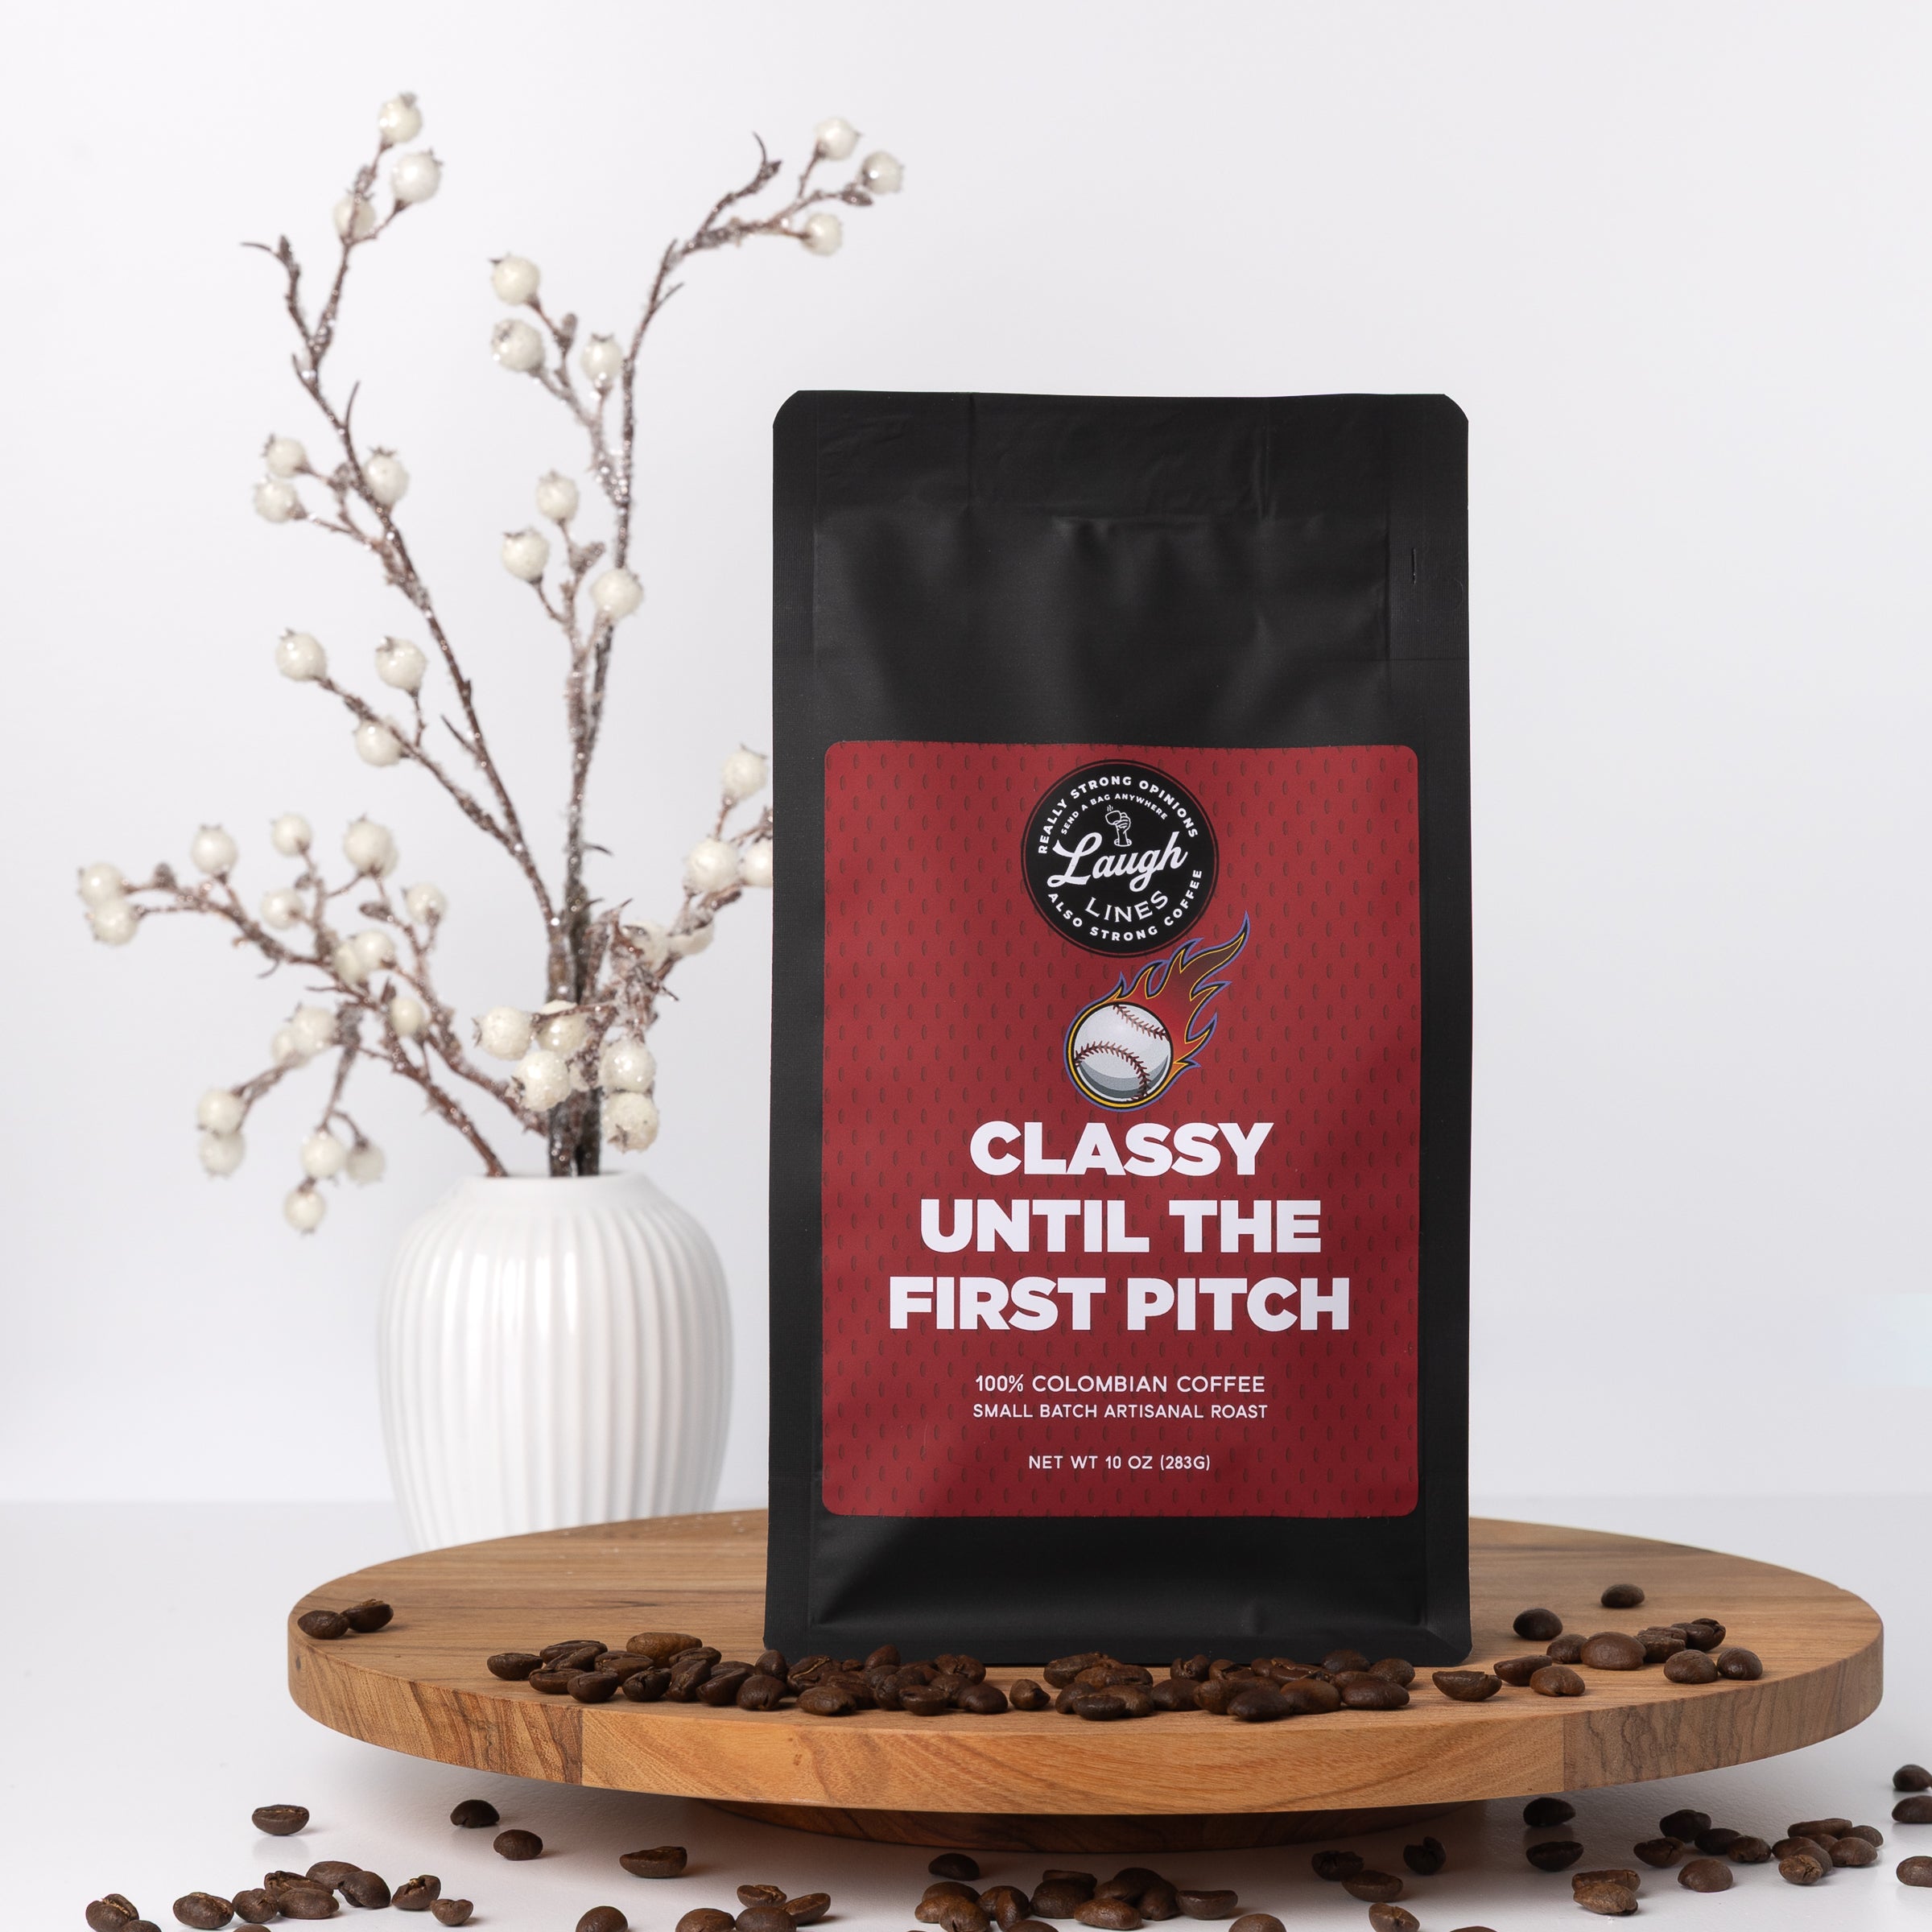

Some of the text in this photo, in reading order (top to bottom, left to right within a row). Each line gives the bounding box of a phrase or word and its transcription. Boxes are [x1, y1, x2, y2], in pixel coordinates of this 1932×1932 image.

[1038, 775, 1199, 854] REALLY STRONG OPINIONS
[1060, 811, 1080, 835] SEND
[1090, 794, 1111, 806] BAG
[1114, 793, 1168, 820] ANYWHERE
[1046, 831, 1189, 893] Laugh
[1047, 869, 1203, 942] ALSO STRONG COFFEE
[1084, 890, 1169, 923] LINES
[970, 1121, 1274, 1176] CLASSY
[921, 1199, 1321, 1253] UNTIL THE
[890, 1277, 1349, 1331] FIRST PITCH
[975, 1373, 1265, 1393] 100% COLOMBIAN COFFEE
[972, 1403, 1268, 1419] SMALL BATCH ARTISANAL ROAST
[1029, 1455, 1210, 1472] NET WT 10 OZ (283G)
